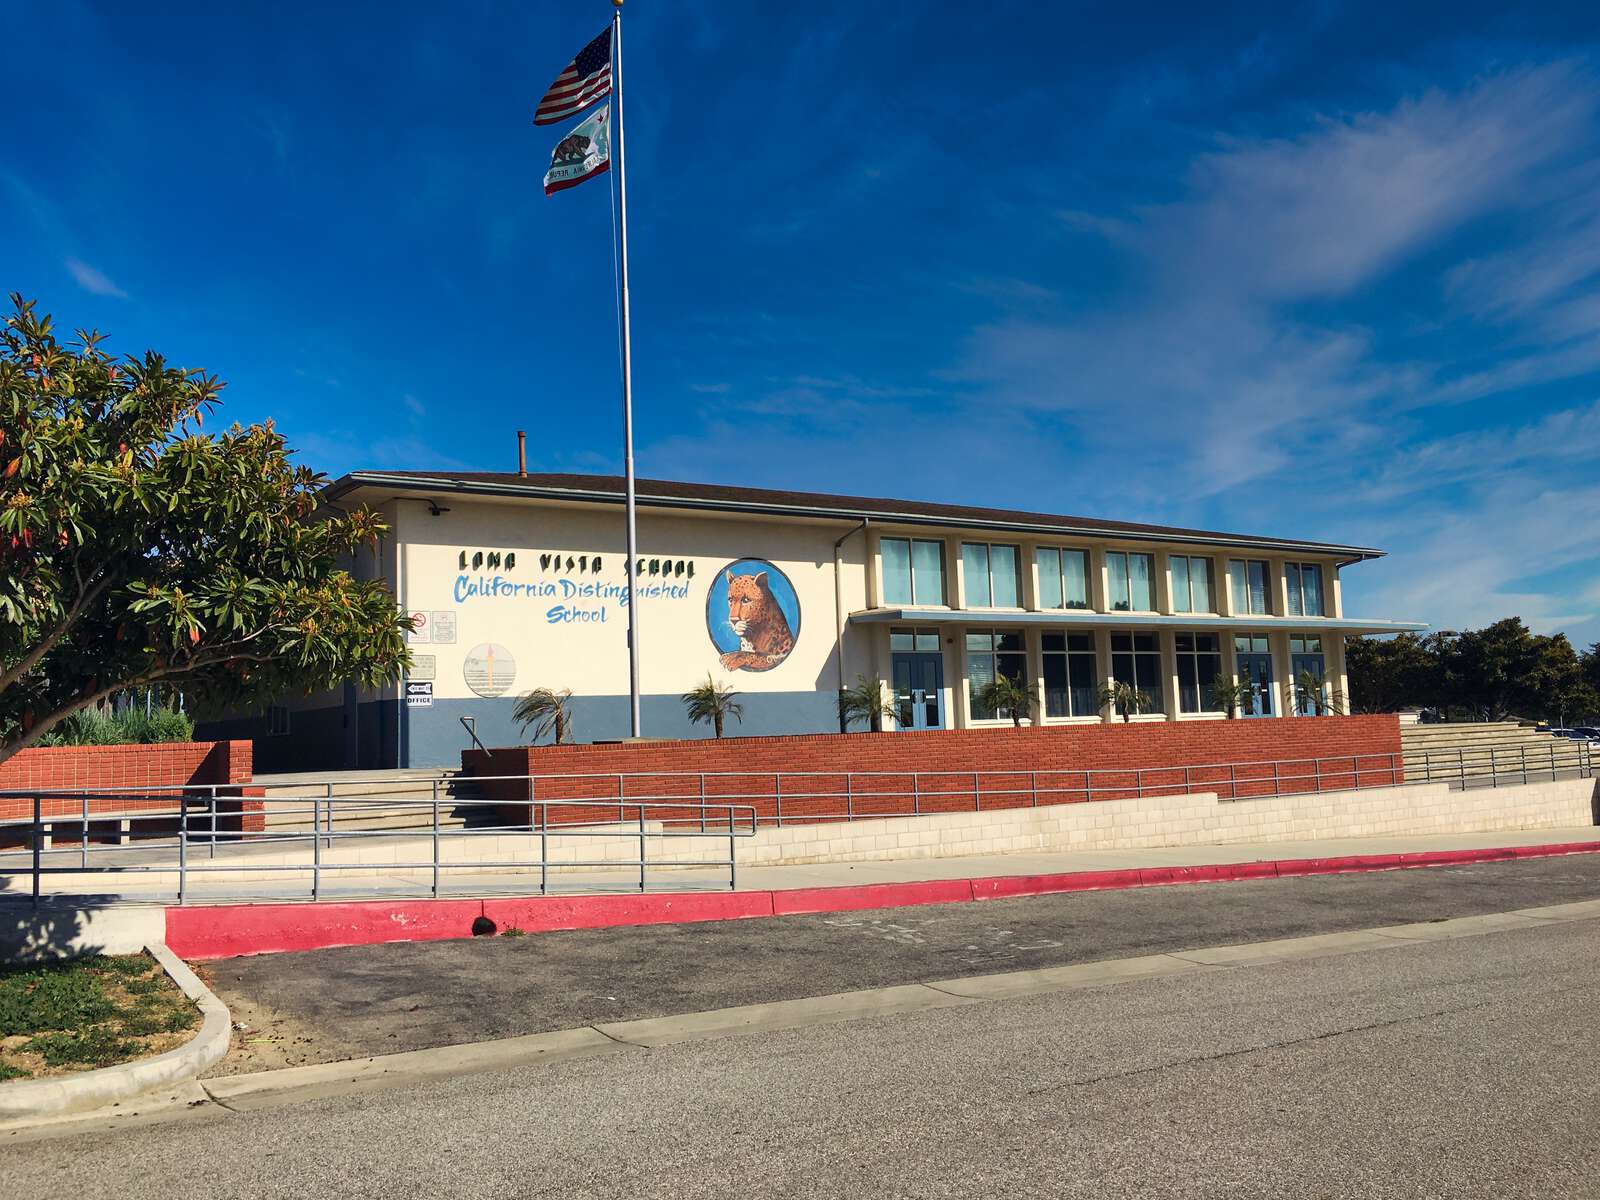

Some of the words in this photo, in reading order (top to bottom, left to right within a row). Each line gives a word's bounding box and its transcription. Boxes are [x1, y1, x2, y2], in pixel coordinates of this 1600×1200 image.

[459, 550, 515, 571] LOMA
[539, 554, 602, 575] VISTA
[454, 575, 556, 603] California
[558, 579, 689, 607] Distinguished
[546, 605, 607, 624] School
